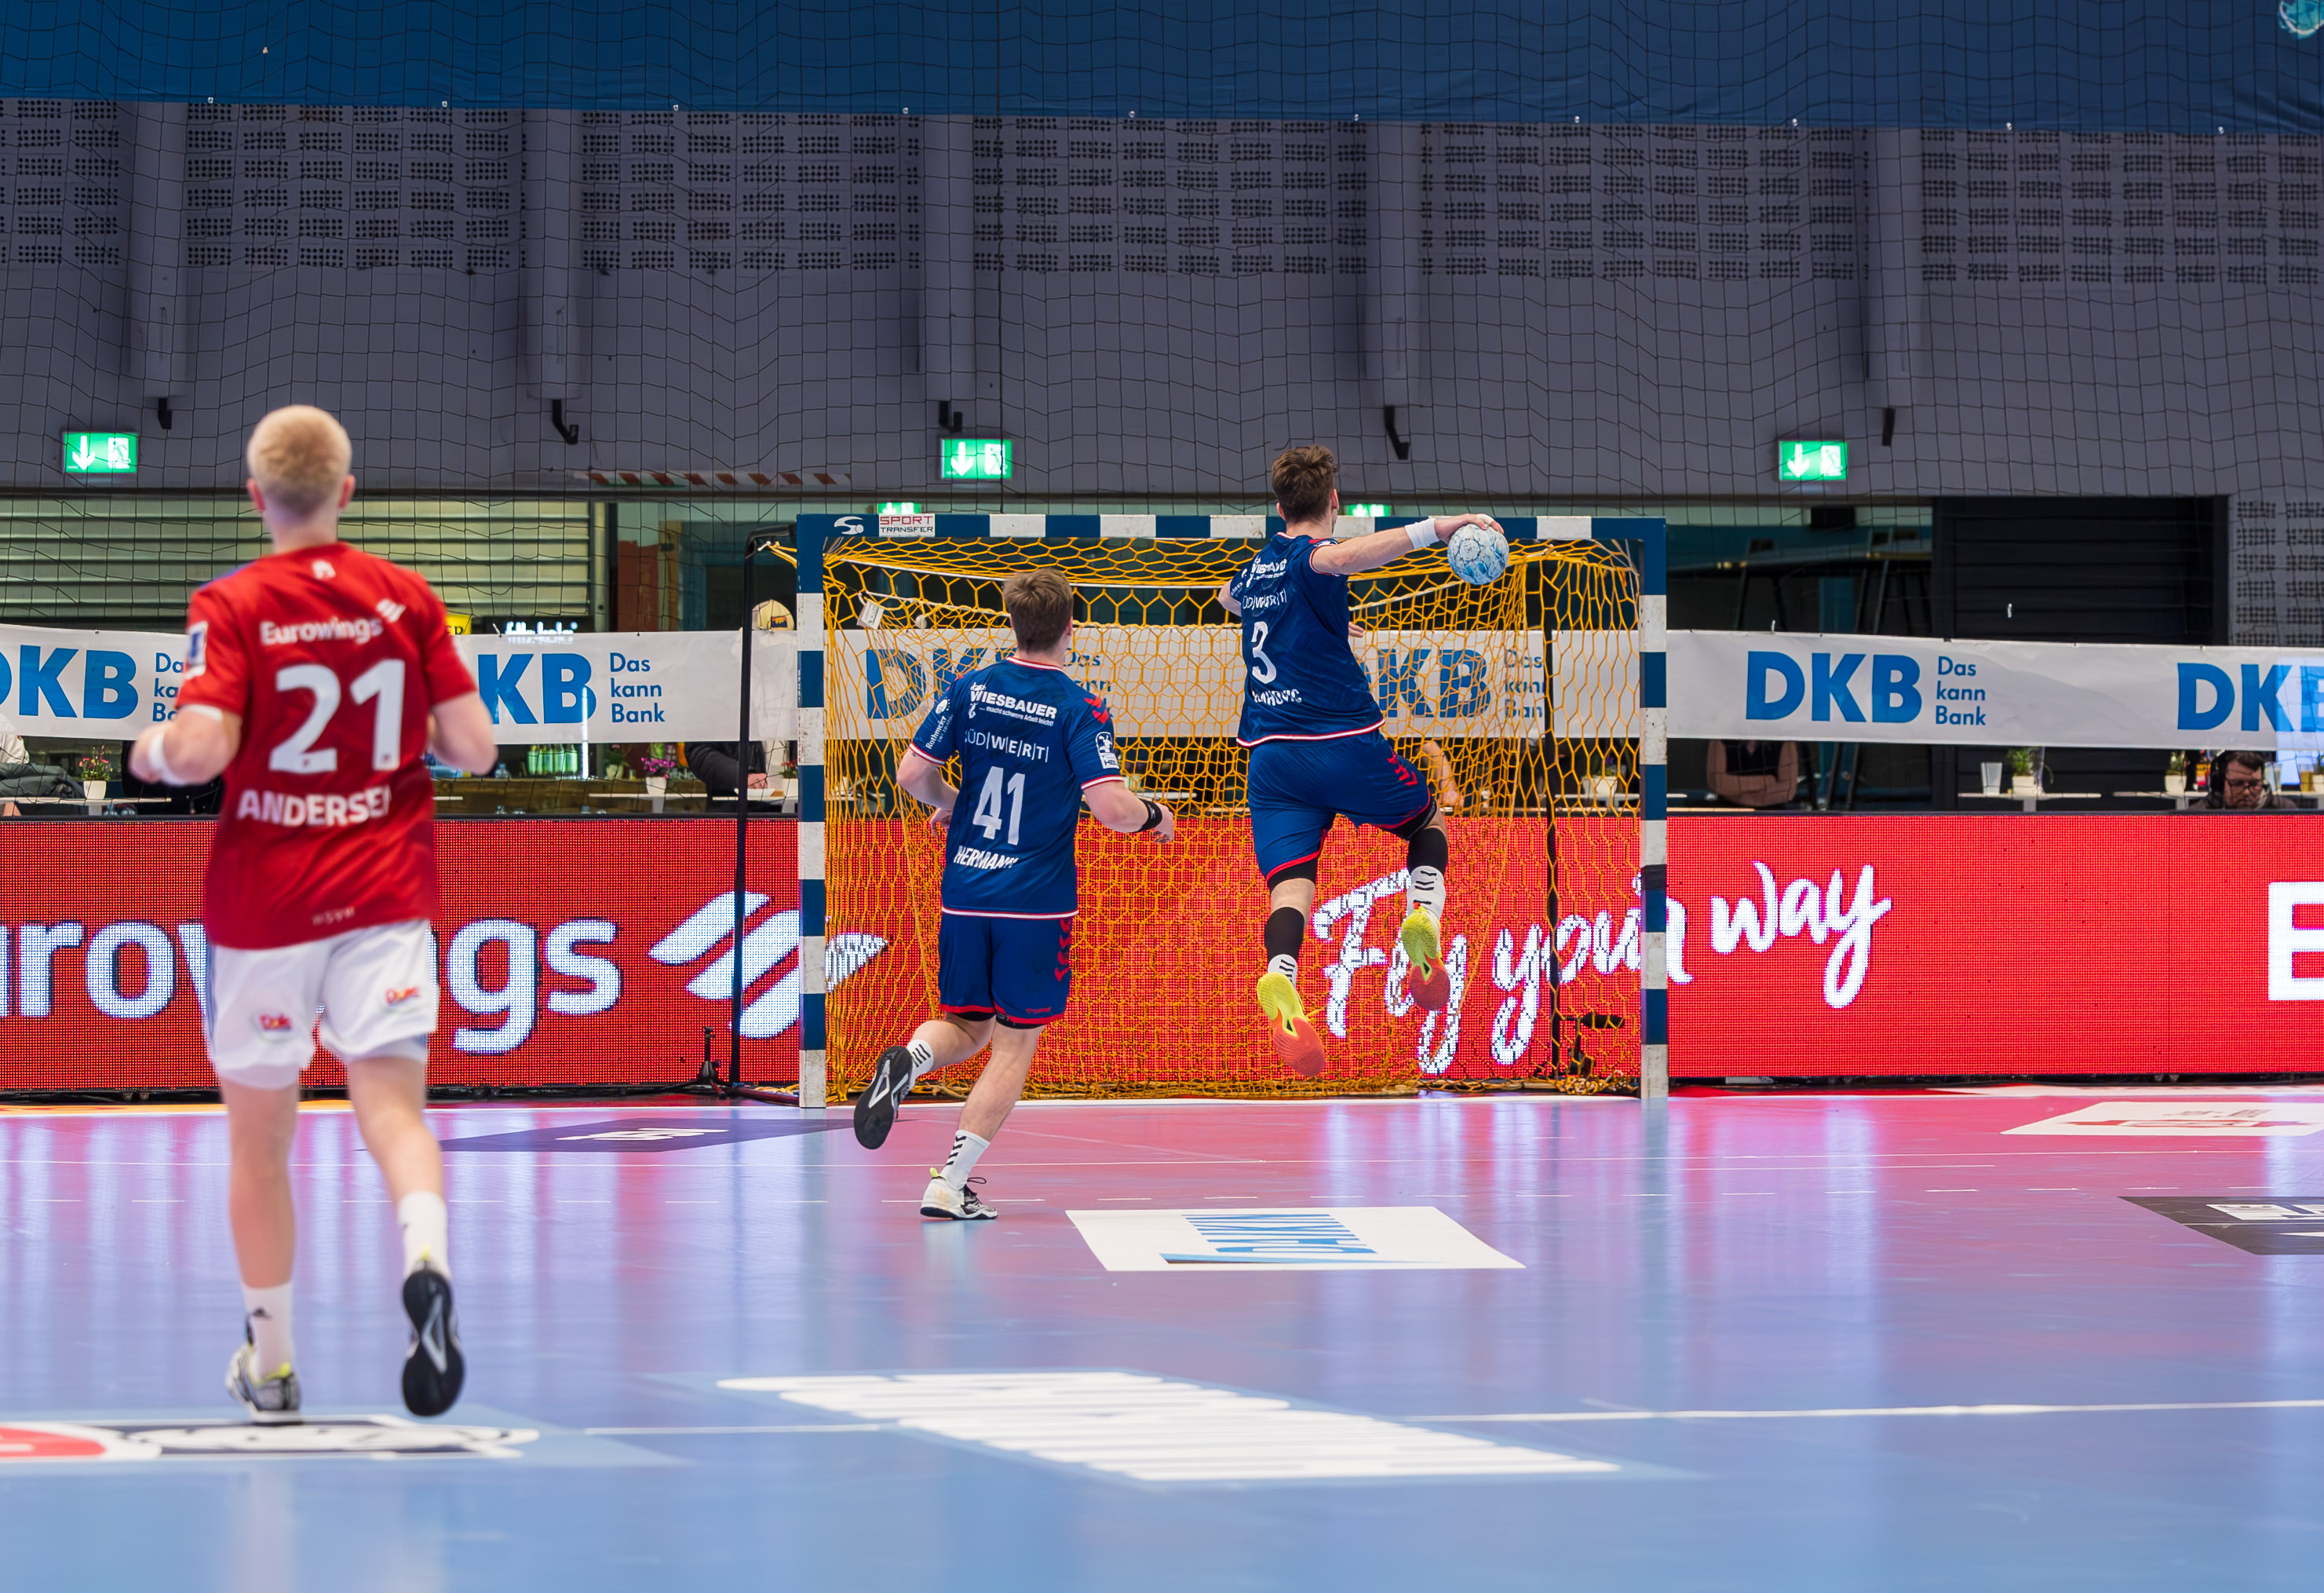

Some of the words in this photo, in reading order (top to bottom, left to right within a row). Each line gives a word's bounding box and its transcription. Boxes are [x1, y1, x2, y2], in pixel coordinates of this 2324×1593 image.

[880, 516, 933, 524] SPORT
[260, 616, 383, 645] Eurowings
[155, 652, 184, 674] Da
[610, 652, 651, 672] Das
[1251, 621, 1277, 684] 3
[1504, 649, 1543, 668] Das
[1938, 656, 1976, 676] Das
[0, 645, 138, 719] KB
[154, 678, 178, 698] ka
[478, 653, 597, 724] KB
[611, 678, 662, 698] kann
[866, 648, 1018, 720] DK
[1356, 649, 1491, 718] KB
[1746, 651, 1922, 723] DKB
[1936, 681, 1986, 701] kann
[152, 703, 177, 722] Ba
[611, 703, 665, 723] Bank
[970, 689, 1058, 719] WIESBAUER
[1505, 699, 1543, 718] Ban
[1935, 705, 1987, 725] Bank
[268, 658, 406, 773] 21
[972, 766, 1026, 846] 41
[1710, 860, 1893, 1009] way
